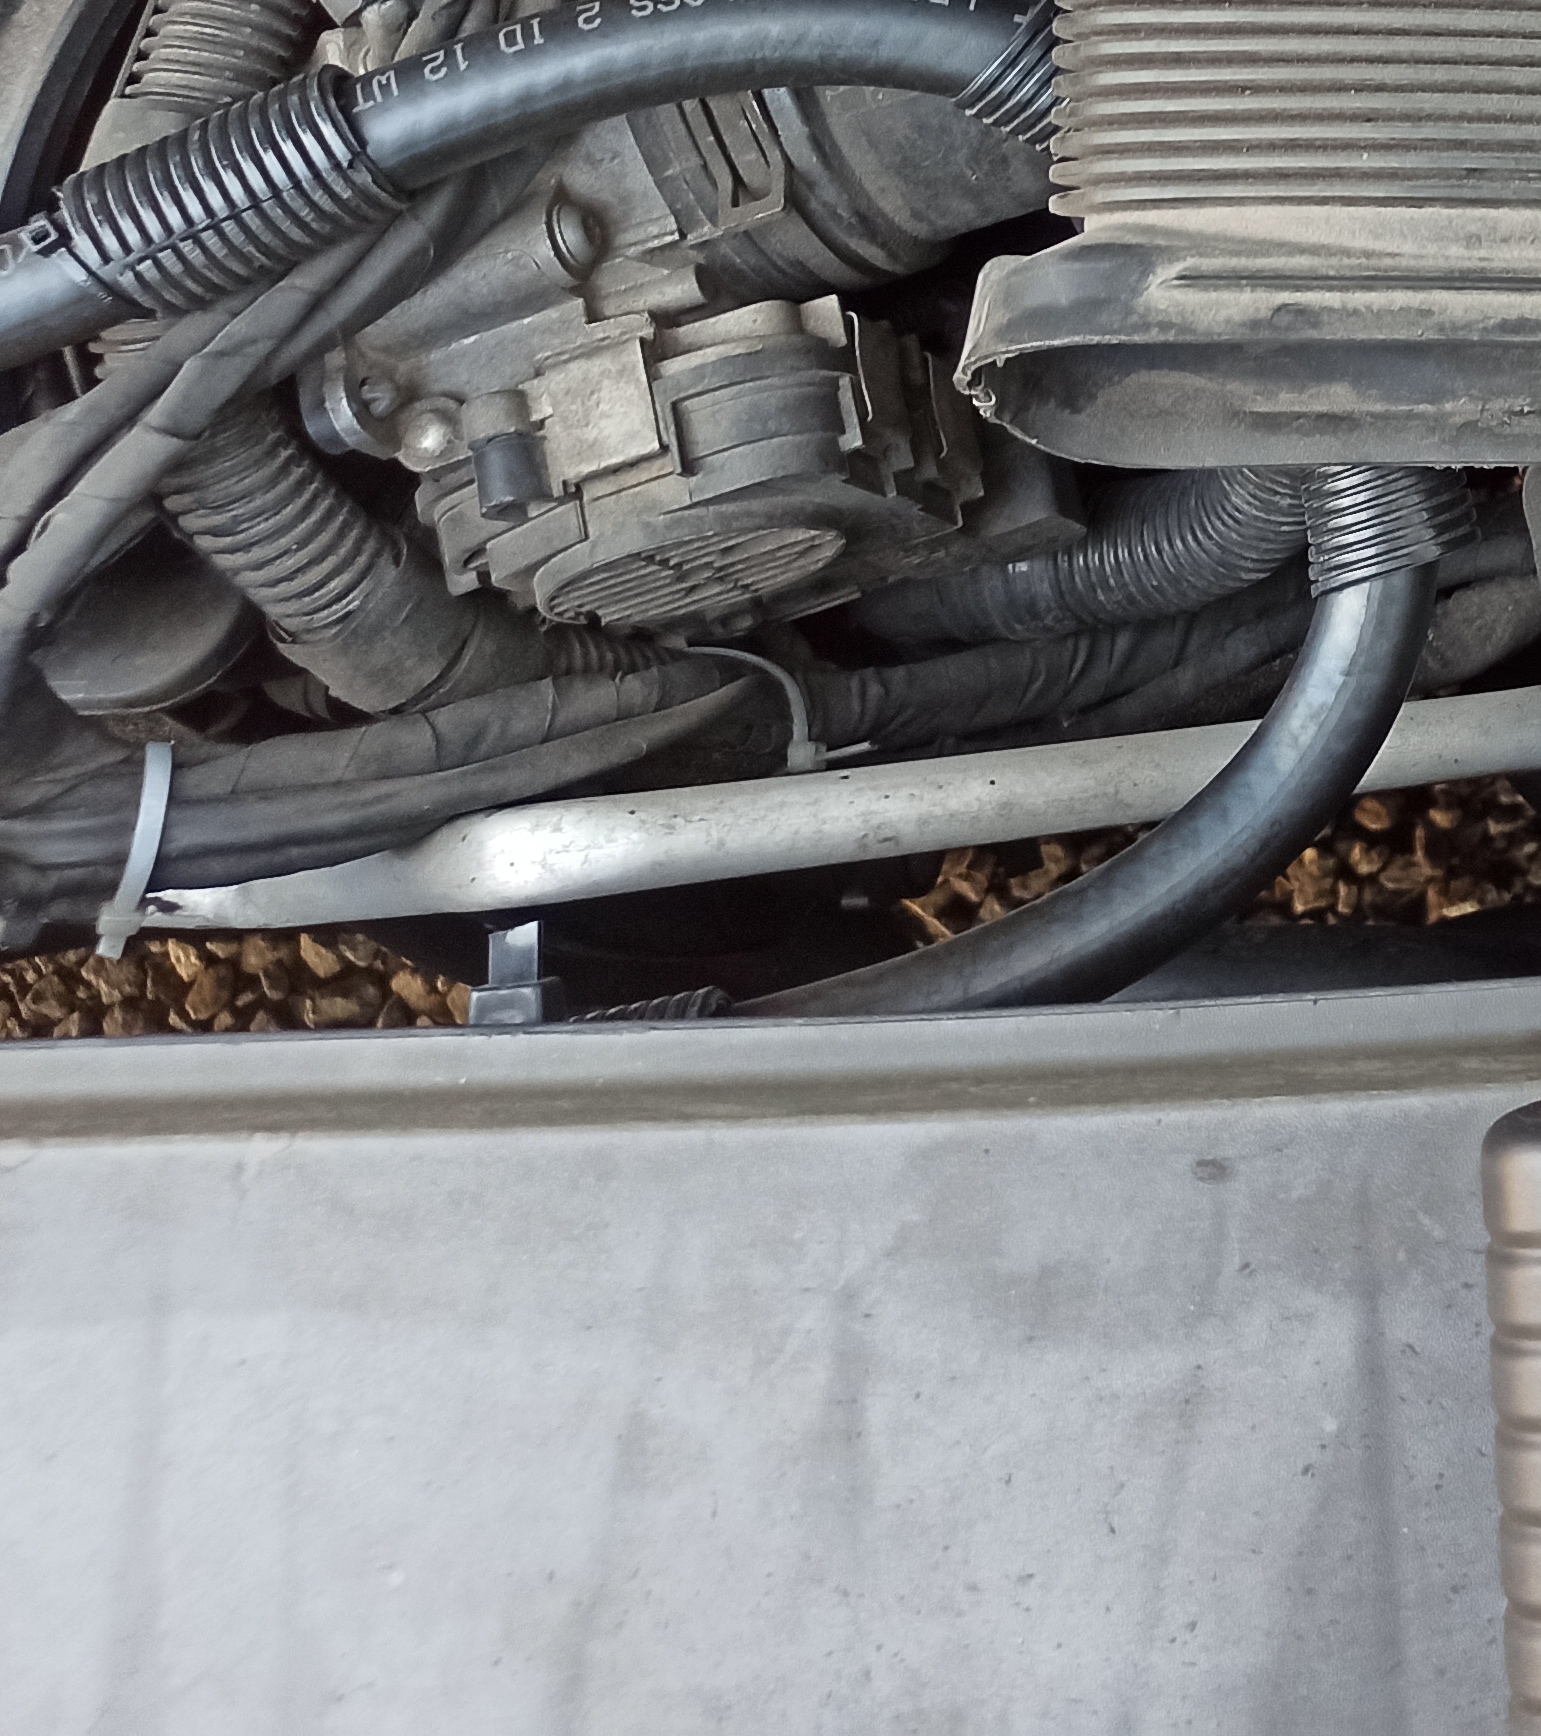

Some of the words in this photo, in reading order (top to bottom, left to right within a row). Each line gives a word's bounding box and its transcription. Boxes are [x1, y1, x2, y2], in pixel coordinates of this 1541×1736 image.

[575, 1, 602, 31] 2
[498, 17, 545, 55] ID
[422, 41, 470, 82] 12
